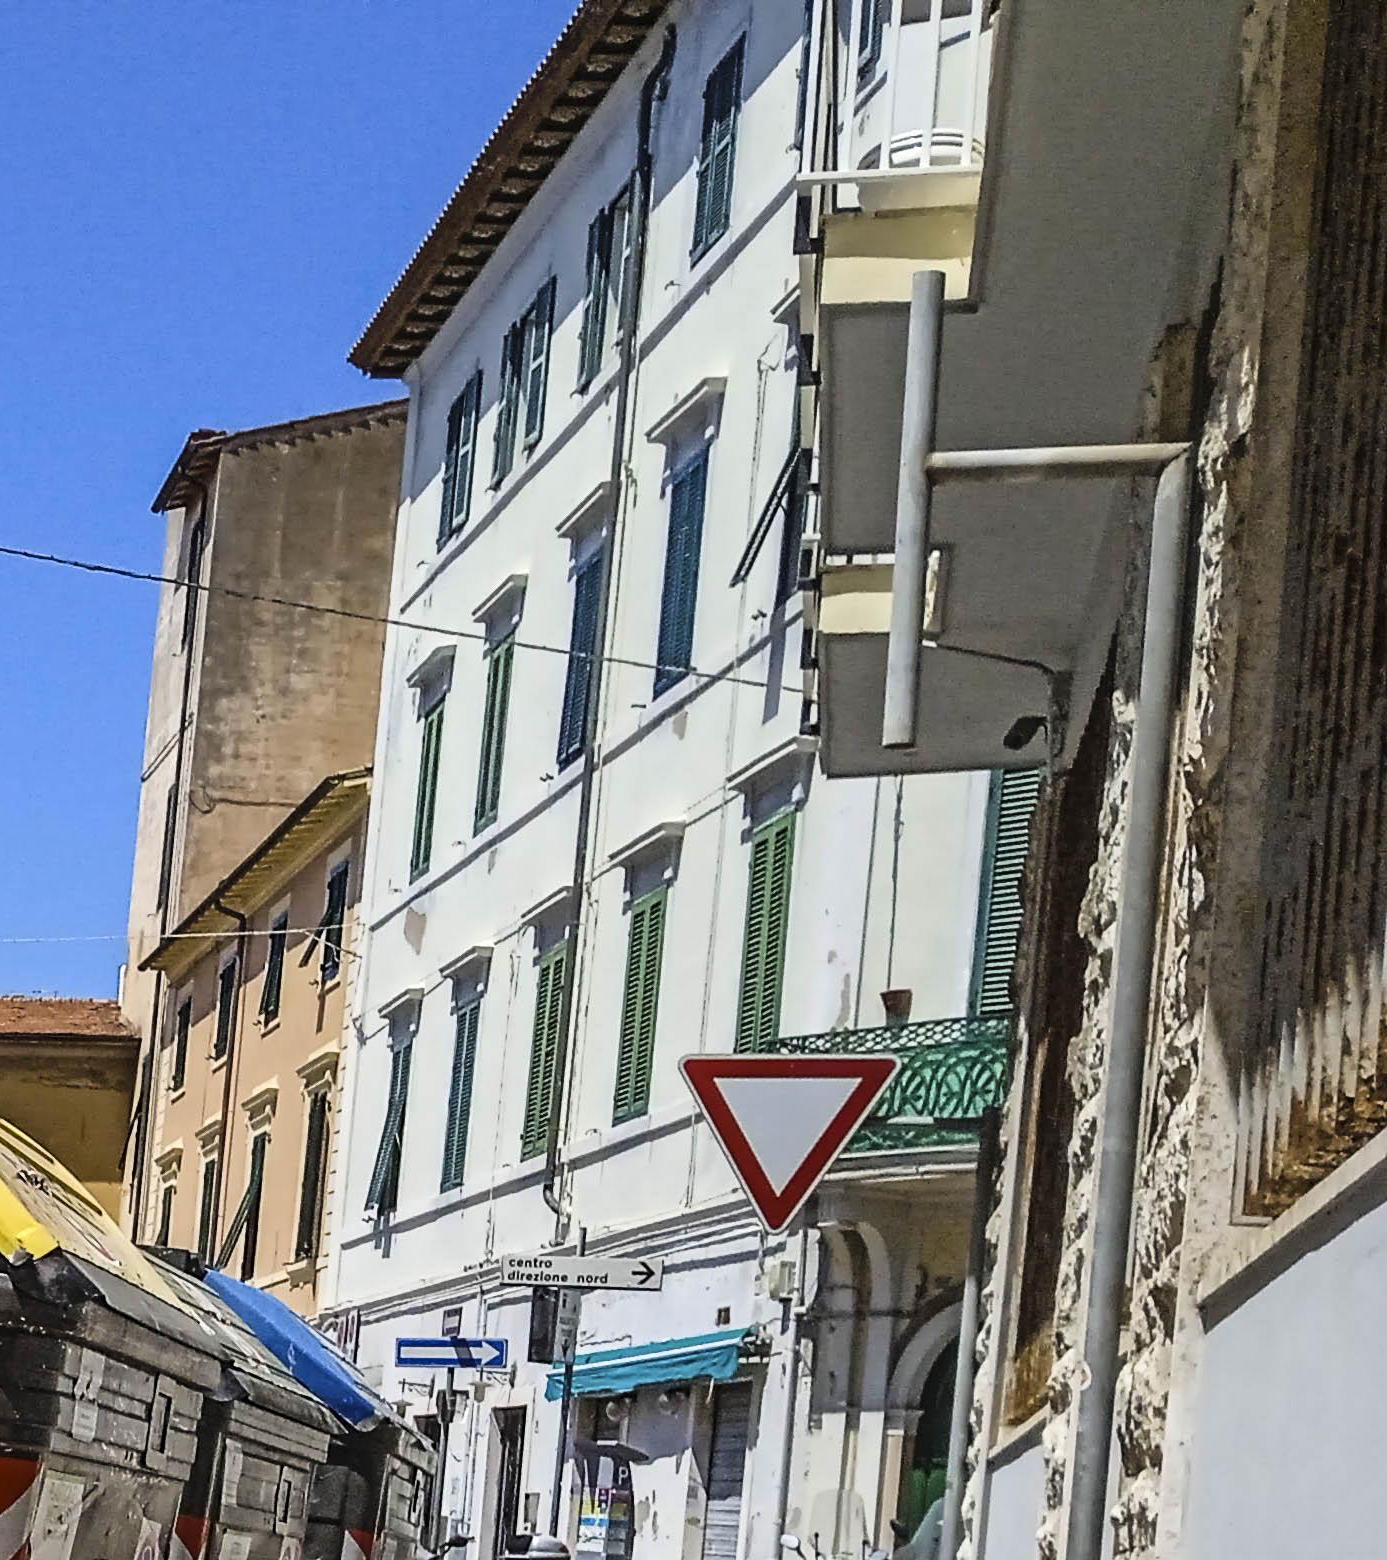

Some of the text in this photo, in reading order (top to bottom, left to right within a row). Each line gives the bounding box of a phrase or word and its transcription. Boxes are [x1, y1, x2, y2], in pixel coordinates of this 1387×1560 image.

[508, 1257, 553, 1269] centro
[507, 1270, 609, 1284] direzione nord
